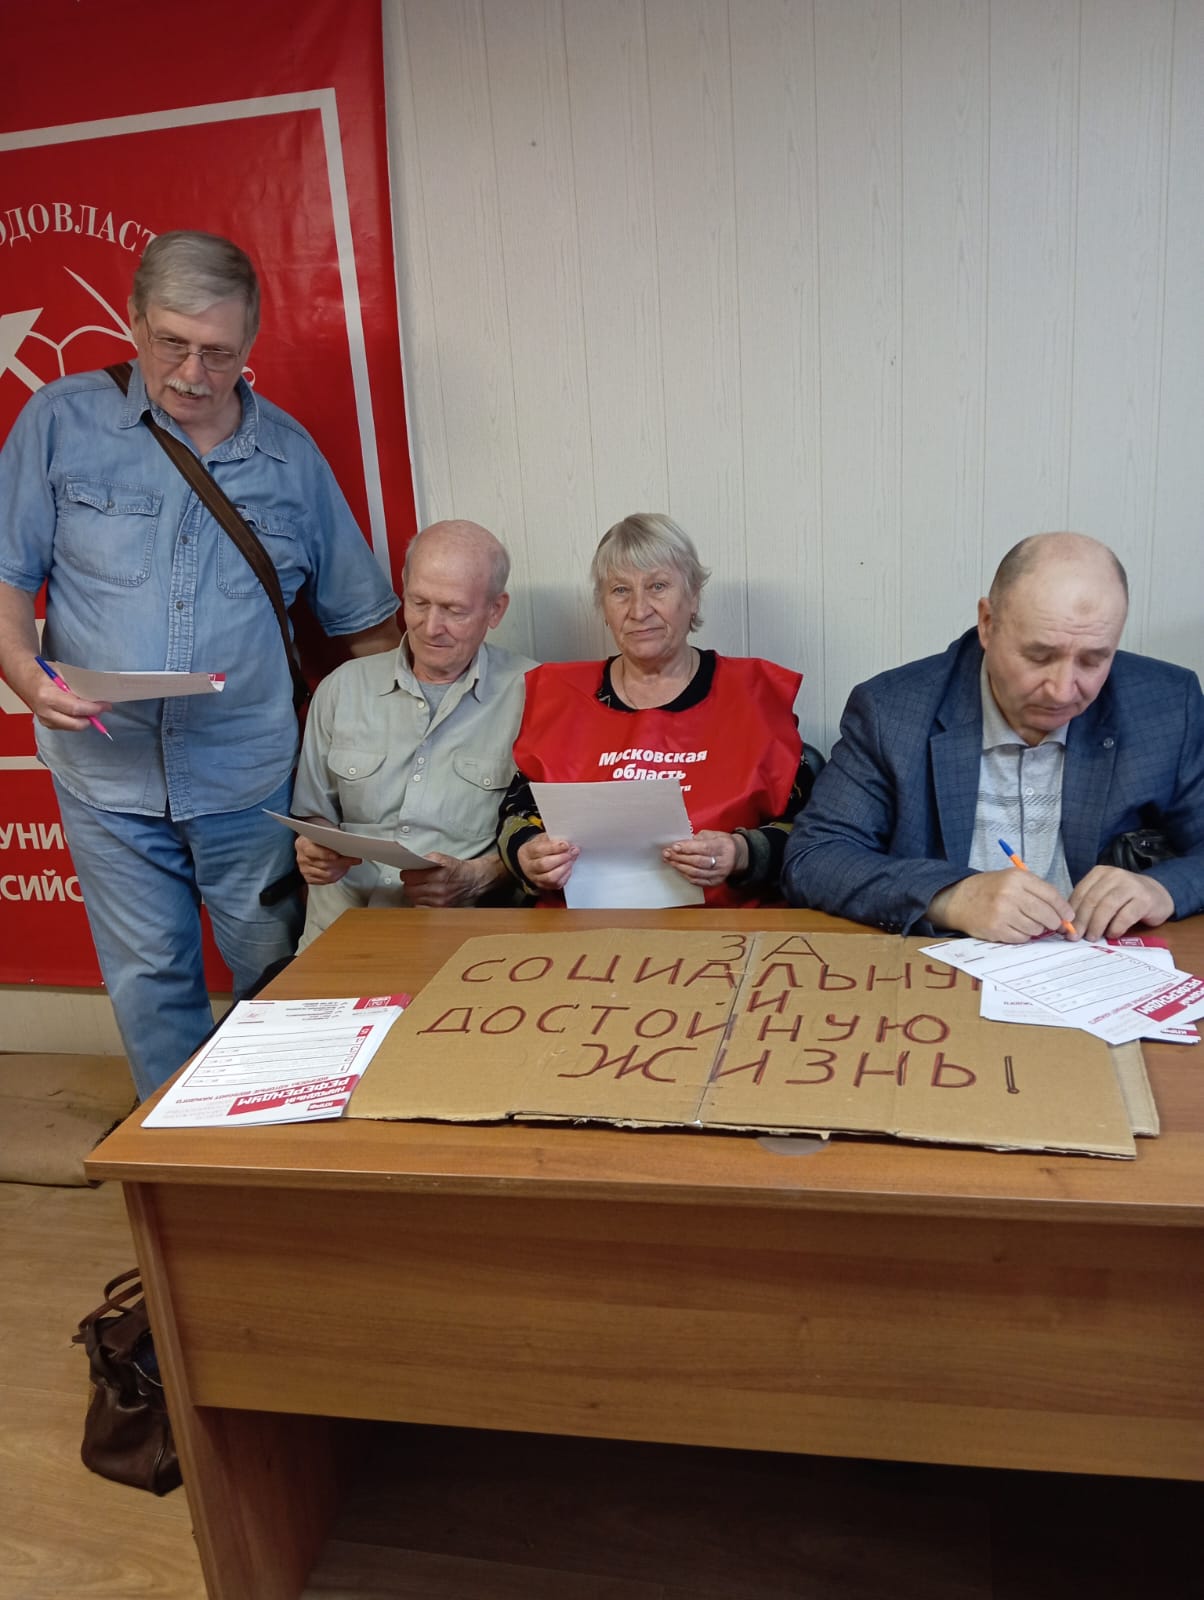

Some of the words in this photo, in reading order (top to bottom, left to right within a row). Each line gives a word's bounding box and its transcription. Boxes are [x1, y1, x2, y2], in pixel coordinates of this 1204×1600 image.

[598, 748, 708, 767] Московская
[612, 763, 687, 781] область
[0, 823, 69, 850] УНИ
[707, 935, 827, 964] ЗА
[746, 990, 791, 1014] И
[416, 1001, 949, 1044] ДОСТОЙНУЮ
[237, 1077, 350, 1106] РЕФЕРЕНДУМ
[284, 1086, 346, 1105] НАРОДНЫЙ
